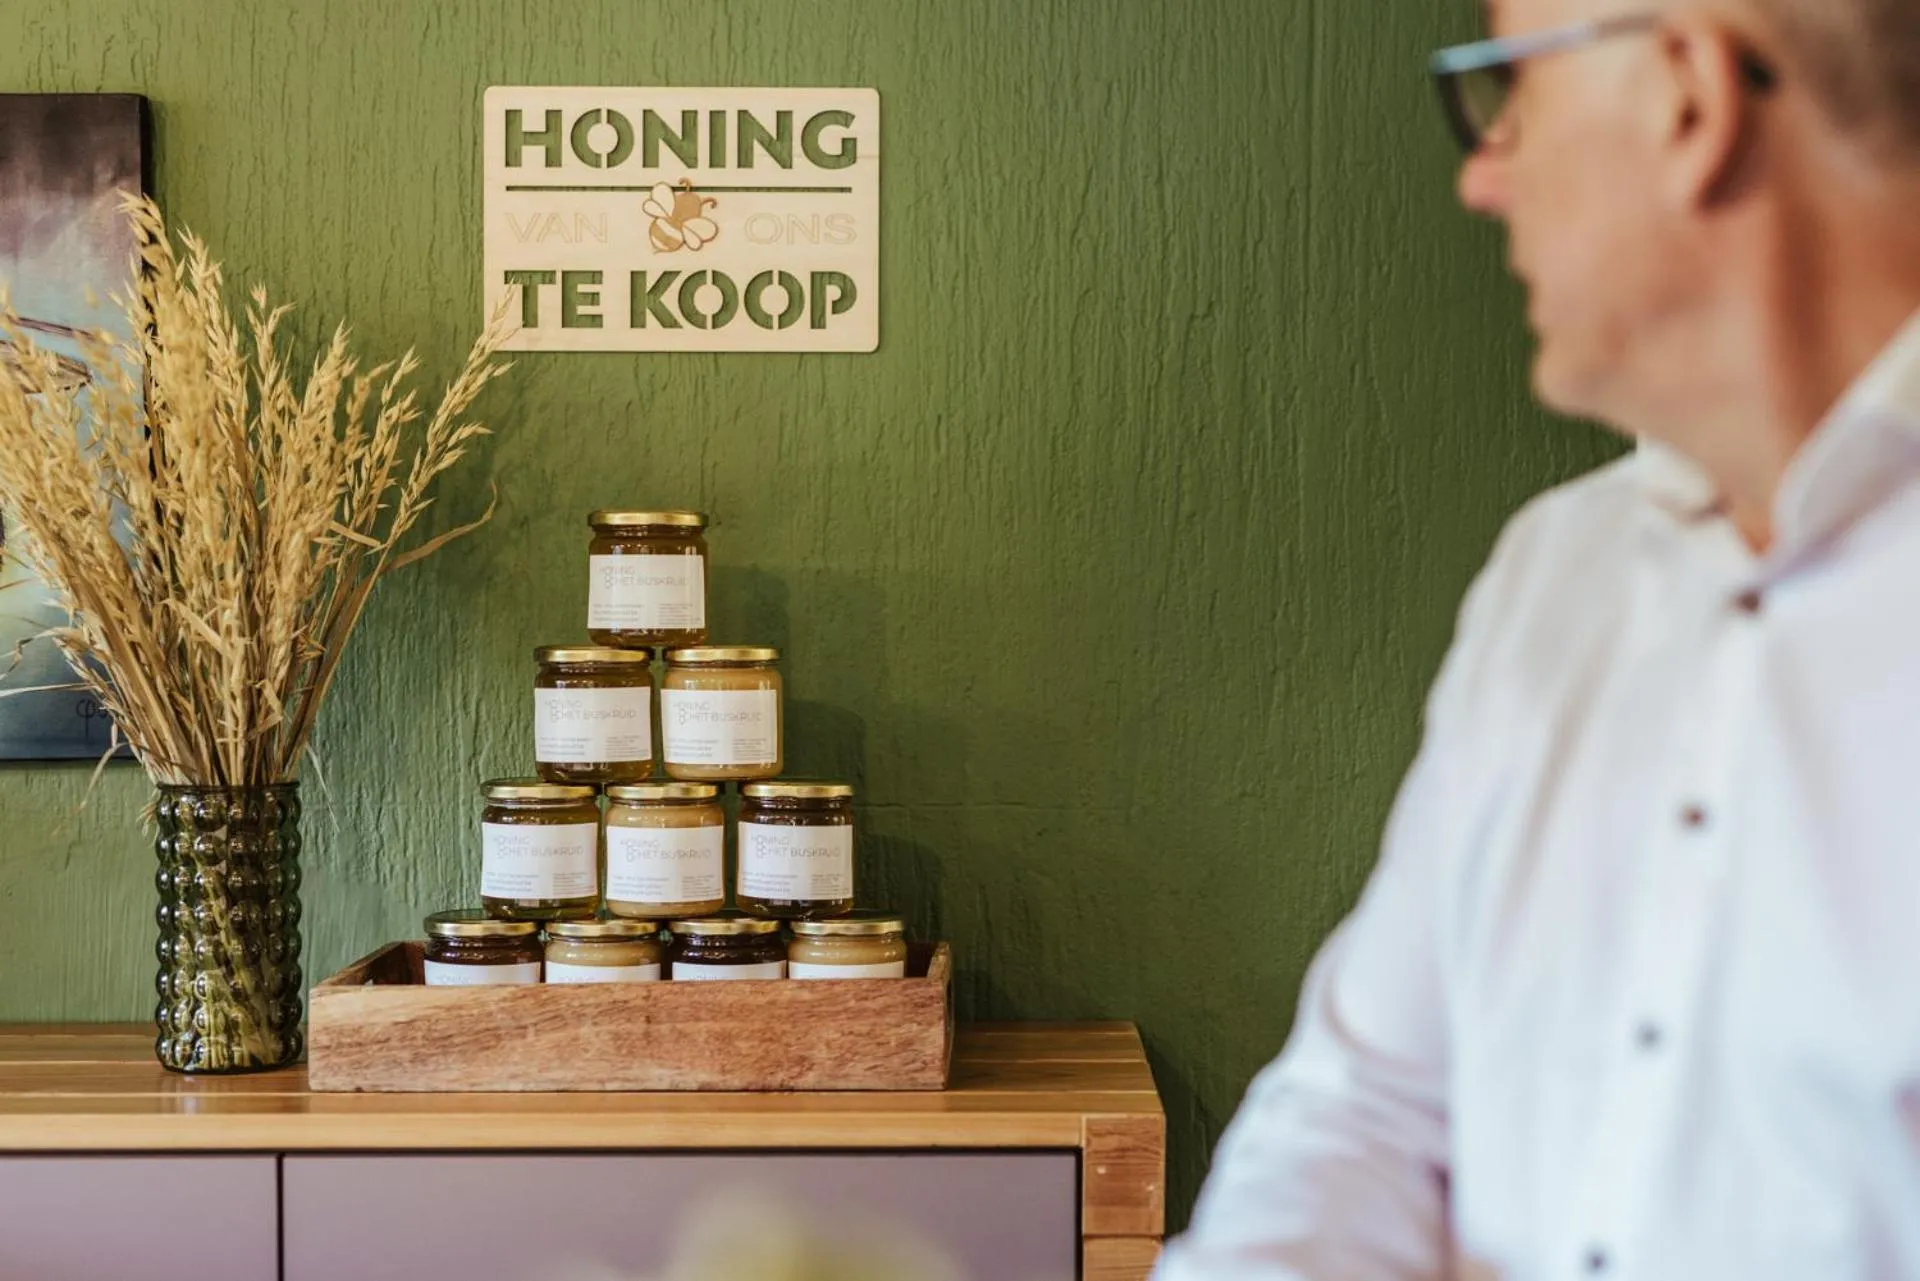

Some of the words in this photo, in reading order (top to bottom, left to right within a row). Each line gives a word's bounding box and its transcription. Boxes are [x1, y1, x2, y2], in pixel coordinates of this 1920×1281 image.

[505, 109, 857, 169] HONING
[504, 212, 608, 243] VAN
[744, 212, 857, 245] ONS
[504, 270, 603, 329] TE
[630, 269, 857, 330] KOOP
